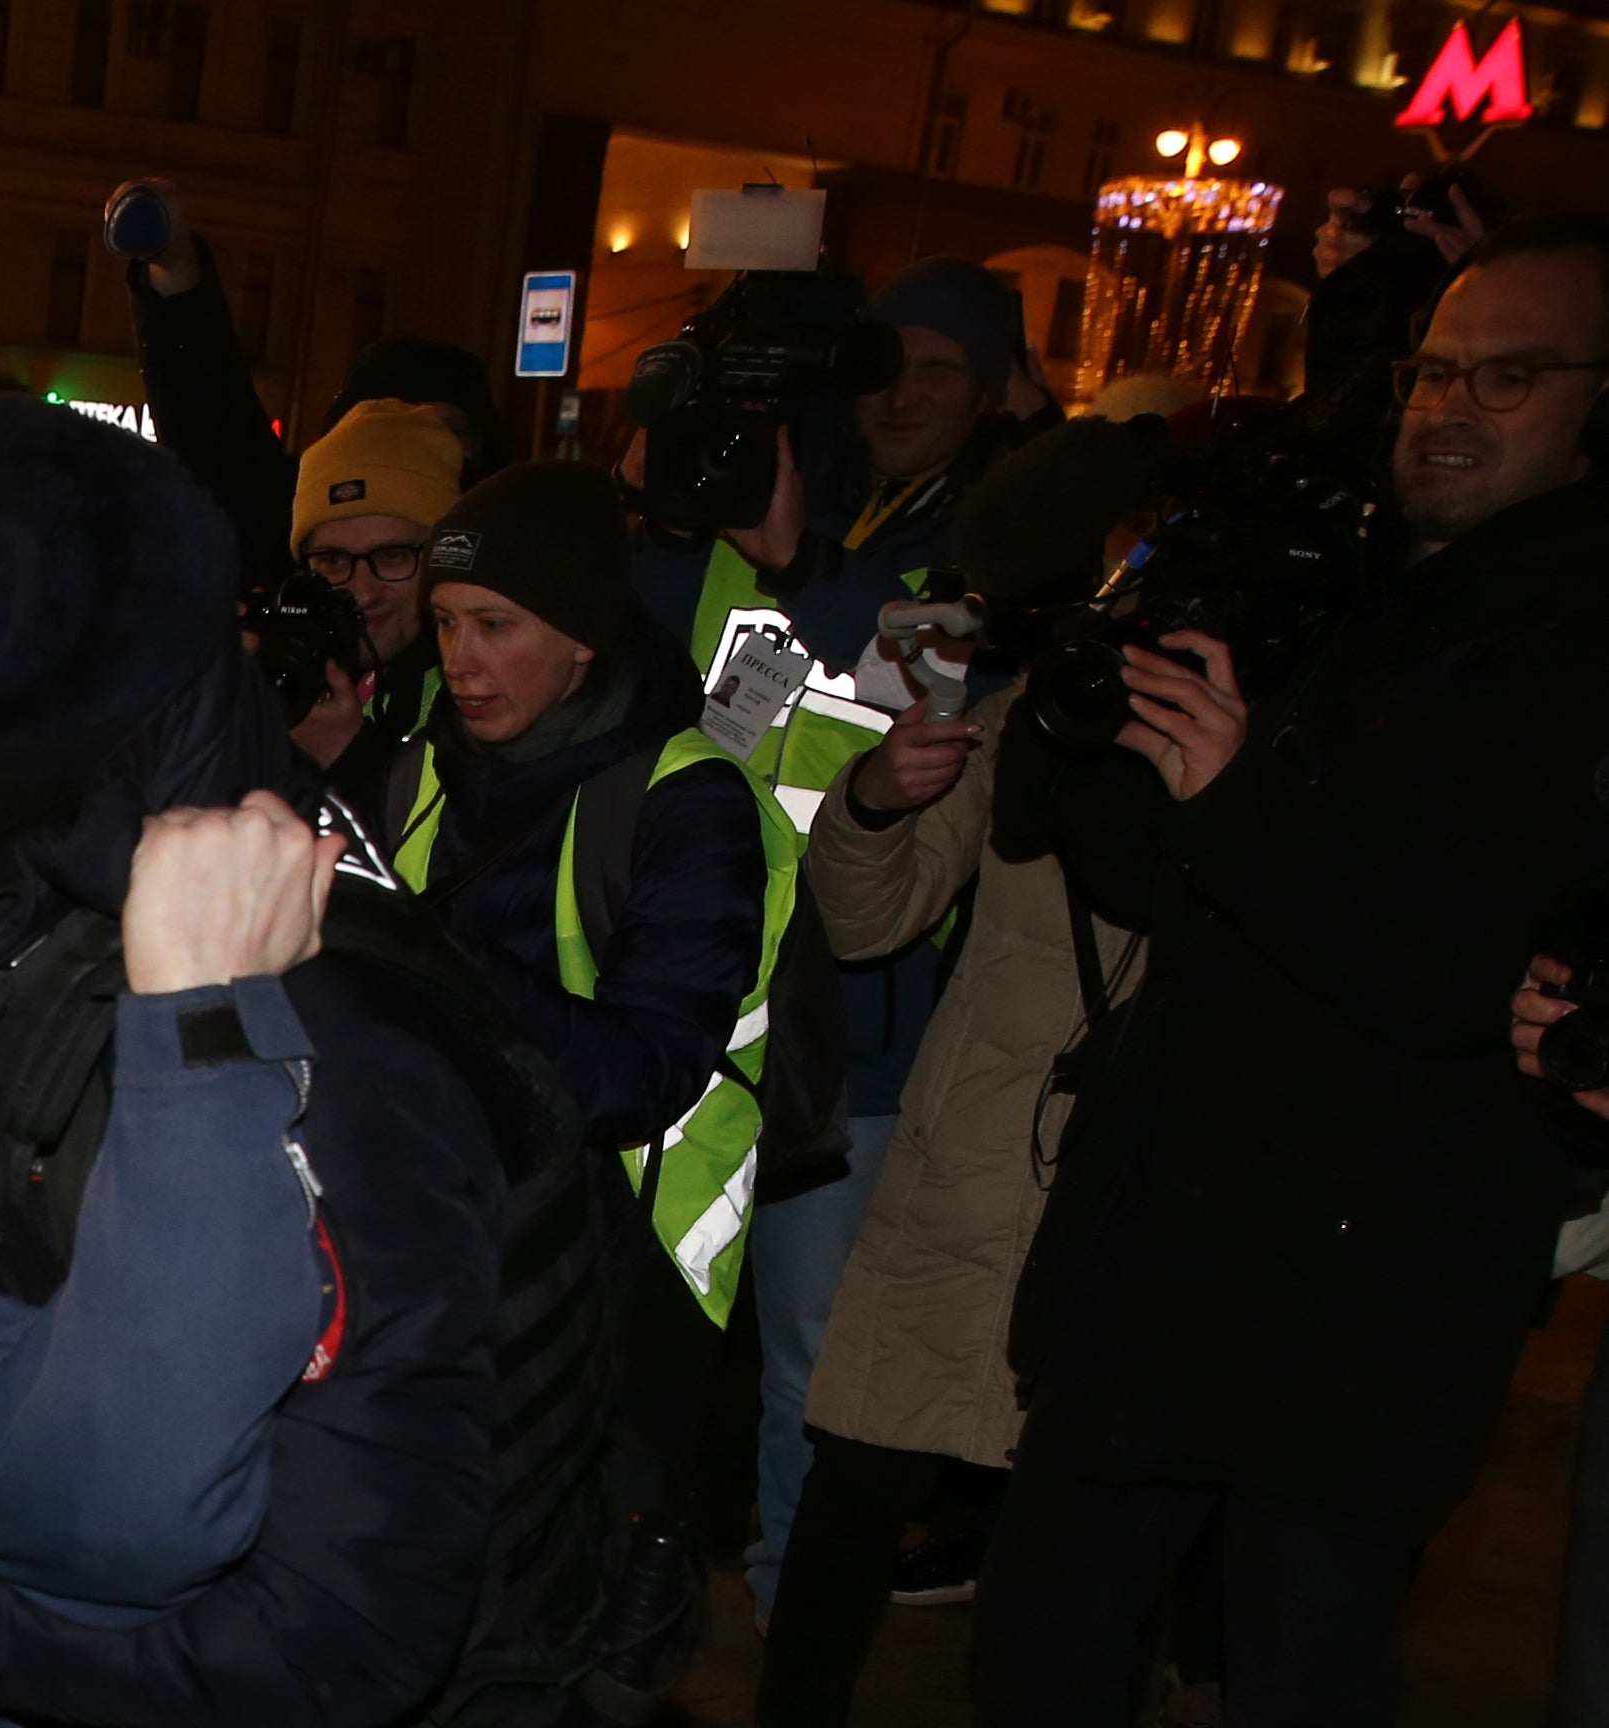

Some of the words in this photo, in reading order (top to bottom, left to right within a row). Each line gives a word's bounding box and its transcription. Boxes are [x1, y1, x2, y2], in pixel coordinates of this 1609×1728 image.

[1394, 16, 1533, 127] М
[60, 400, 139, 434] ПТЕКА
[1288, 548, 1322, 560] SONY
[280, 606, 308, 614] Nikon
[741, 654, 790, 689] ПРЕССА
